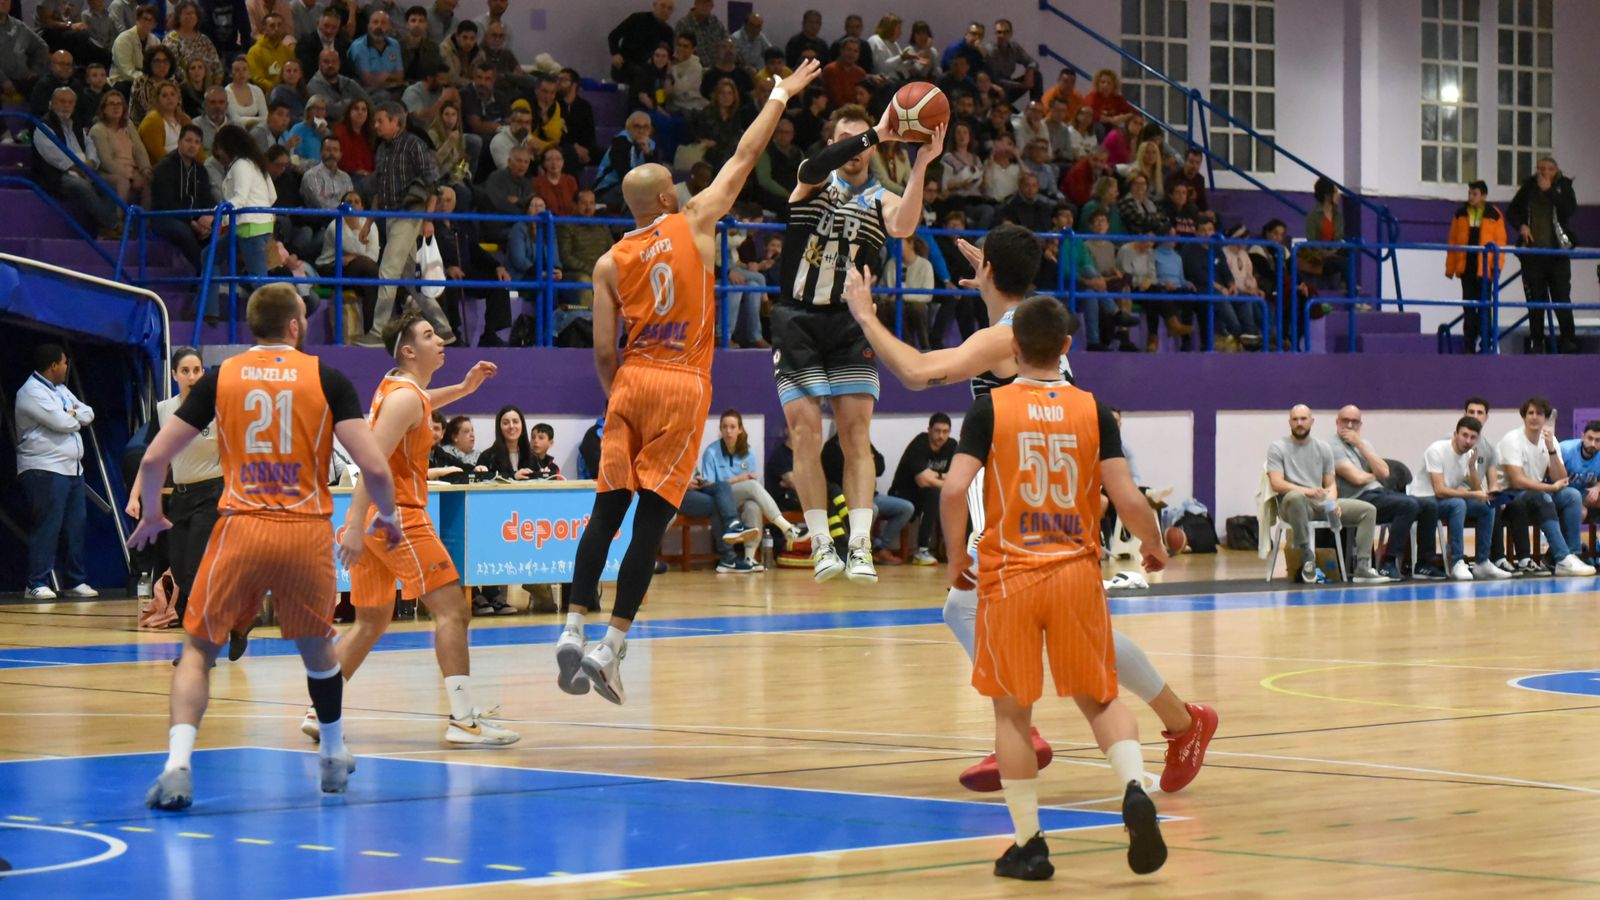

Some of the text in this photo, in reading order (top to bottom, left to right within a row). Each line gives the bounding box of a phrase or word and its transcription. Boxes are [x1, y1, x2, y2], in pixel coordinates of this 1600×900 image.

[650, 262, 674, 316] 0
[241, 366, 297, 382] CHAZELAS
[244, 388, 293, 454] 21
[1027, 403, 1064, 422] MARIO
[1018, 431, 1079, 509] 55
